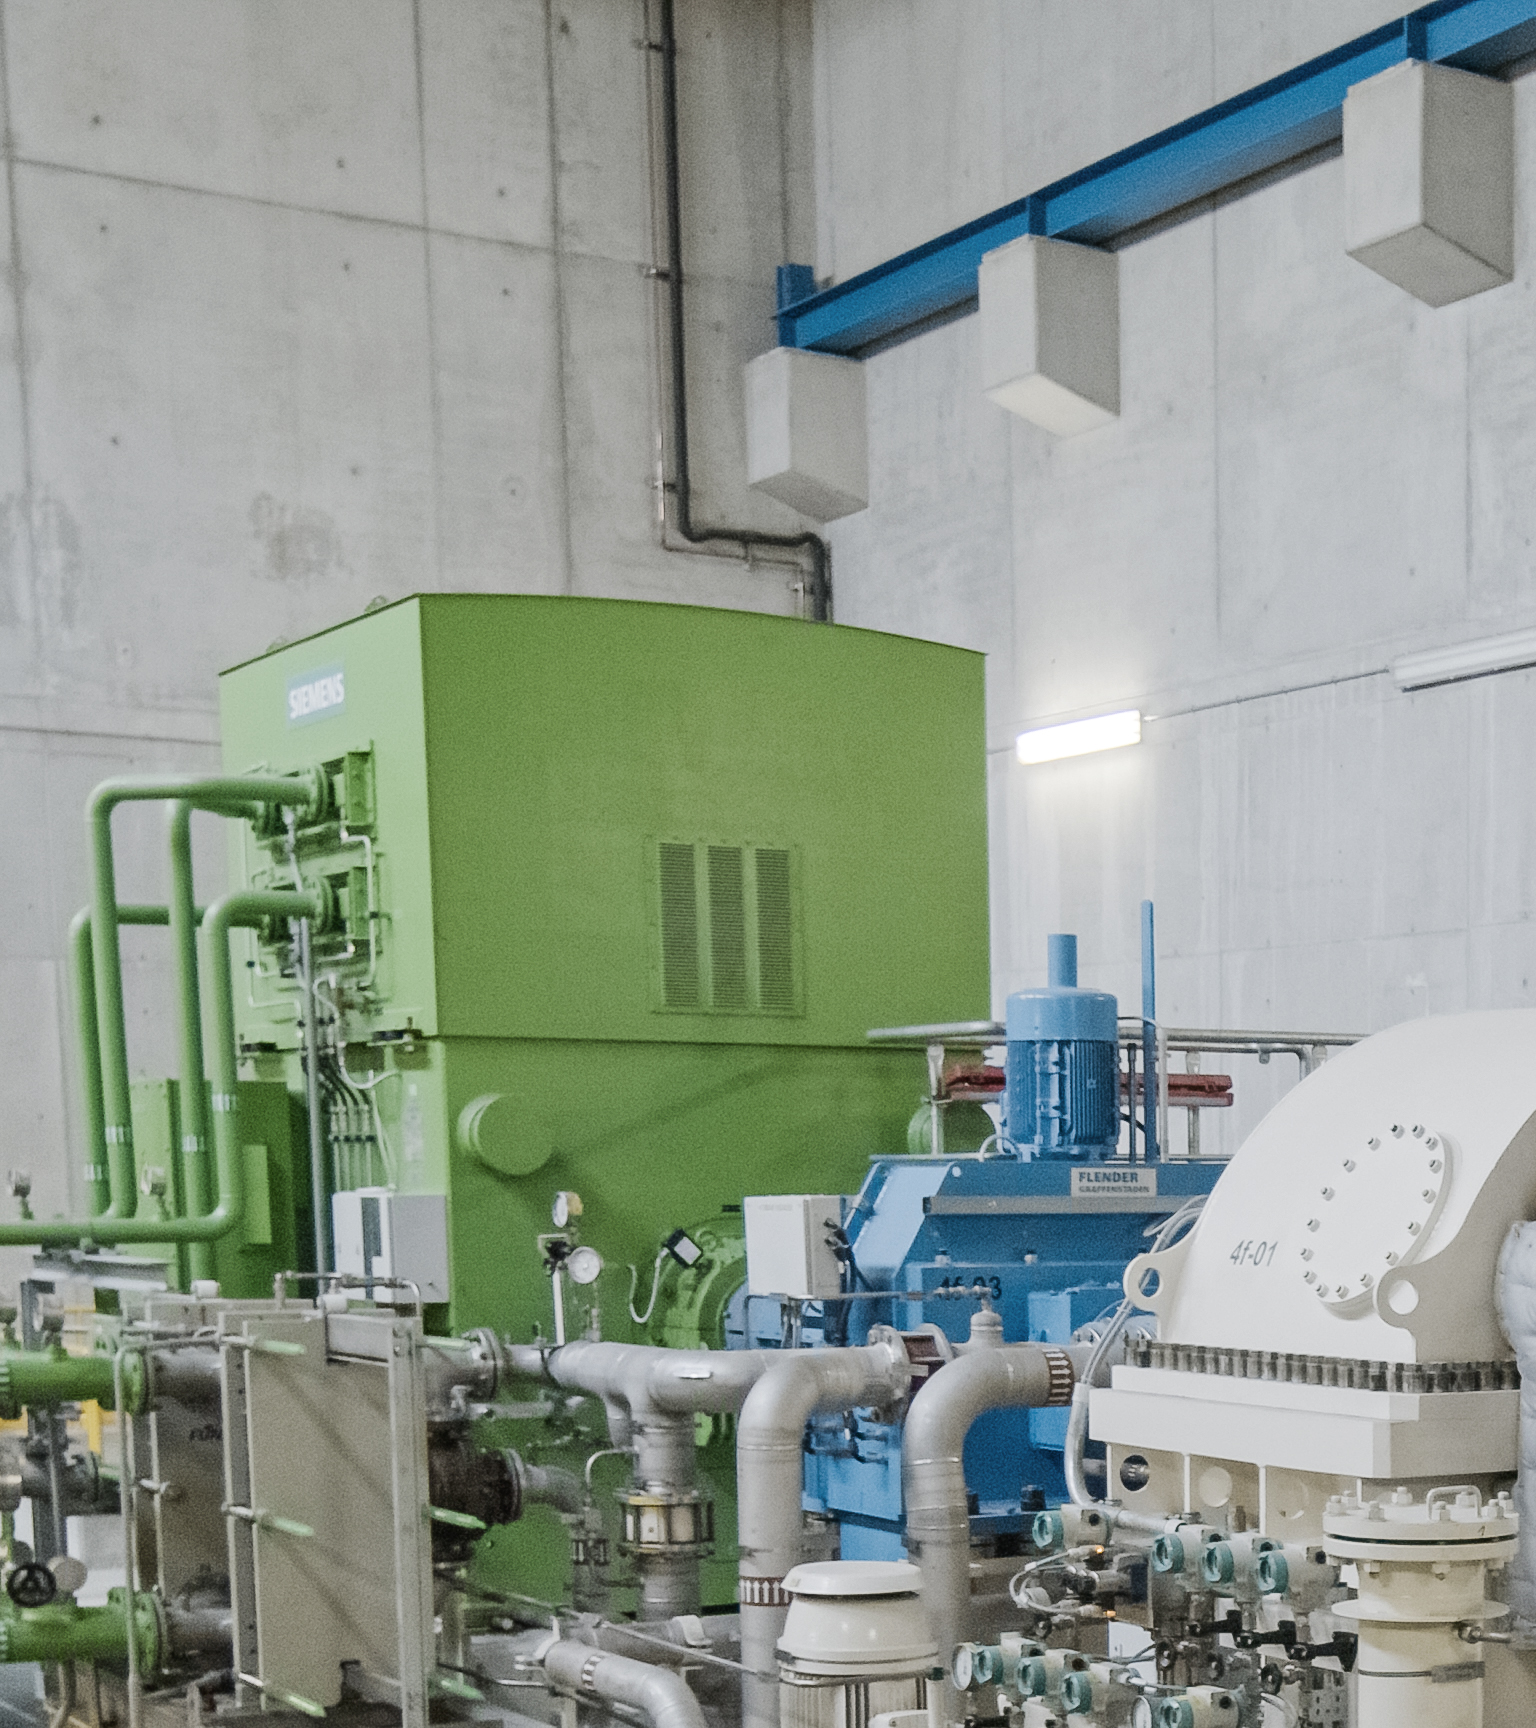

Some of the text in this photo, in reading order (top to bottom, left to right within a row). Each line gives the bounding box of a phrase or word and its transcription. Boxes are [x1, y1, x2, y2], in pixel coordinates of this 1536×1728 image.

[289, 672, 345, 719] SIEMENS
[1078, 1171, 1139, 1183] FLENDER
[1229, 1239, 1279, 1267] 4f-01
